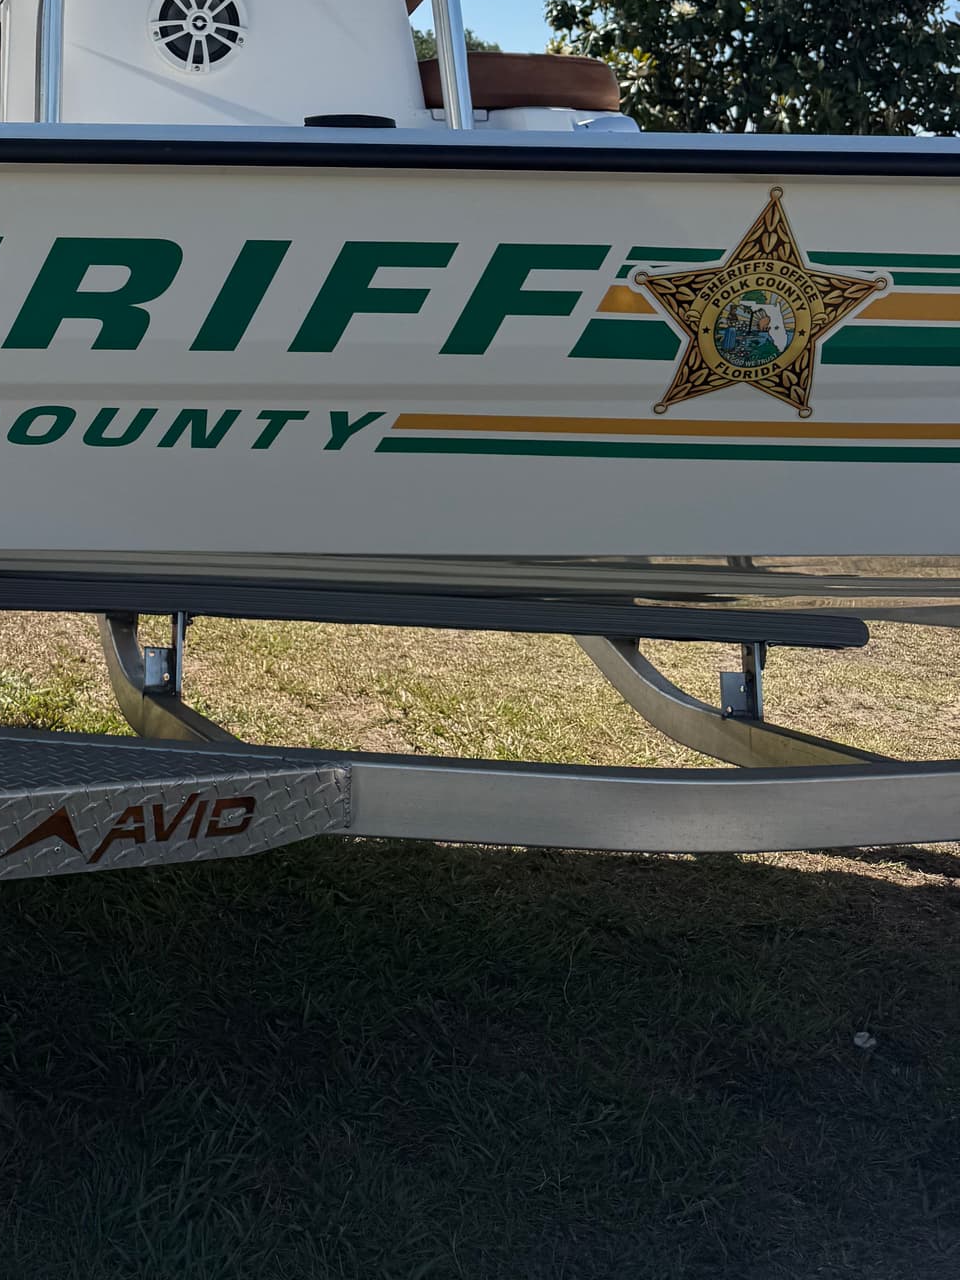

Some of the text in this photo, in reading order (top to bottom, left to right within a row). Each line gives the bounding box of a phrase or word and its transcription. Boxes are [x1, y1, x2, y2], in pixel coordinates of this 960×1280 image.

[700, 262, 818, 303] SHERIFF'S OFFICE
[711, 276, 807, 313] POLK COUNTY
[714, 362, 782, 379] FLORIDA
[758, 353, 777, 365] TRUST
[86, 792, 257, 864] AVID
